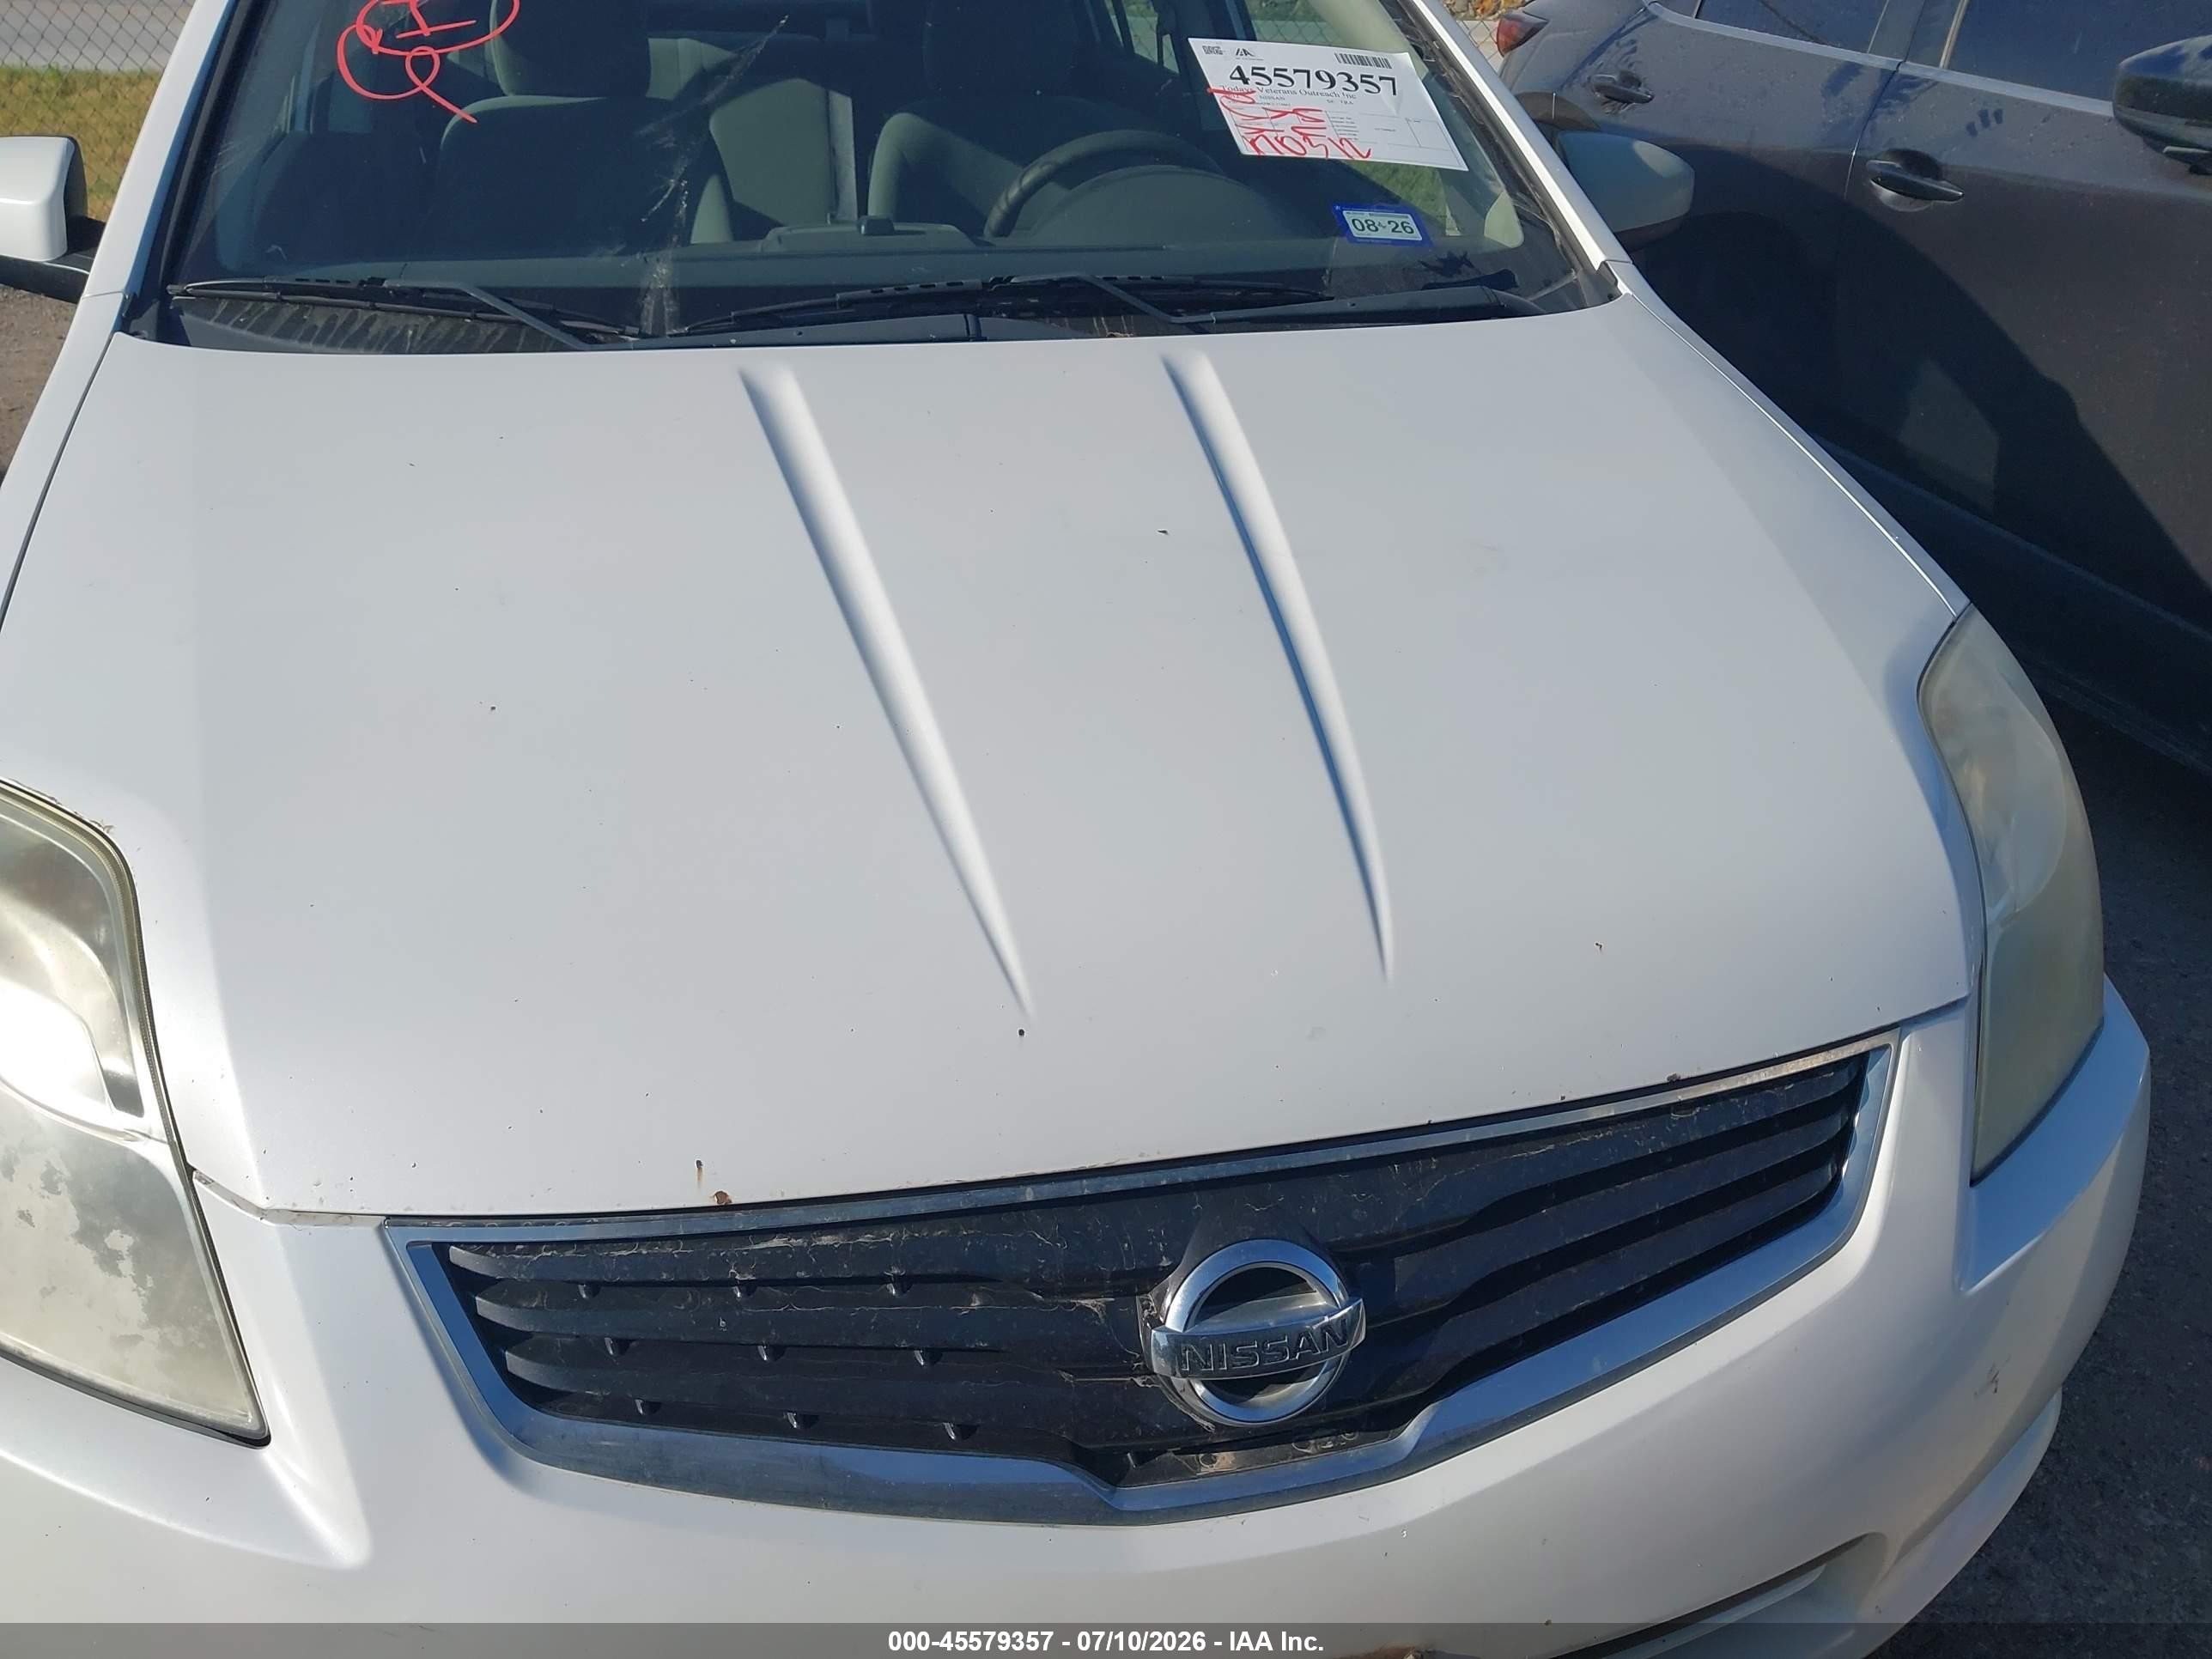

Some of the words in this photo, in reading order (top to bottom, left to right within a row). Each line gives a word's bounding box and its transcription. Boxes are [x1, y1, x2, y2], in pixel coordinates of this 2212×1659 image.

[1230, 65, 1397, 96] 45579357
[1256, 87, 1297, 95] Veterans
[1298, 88, 1340, 98] Outreach
[1351, 218, 1379, 233] 08
[1387, 220, 1414, 234] 26
[1181, 1318, 1347, 1372] NISSAN
